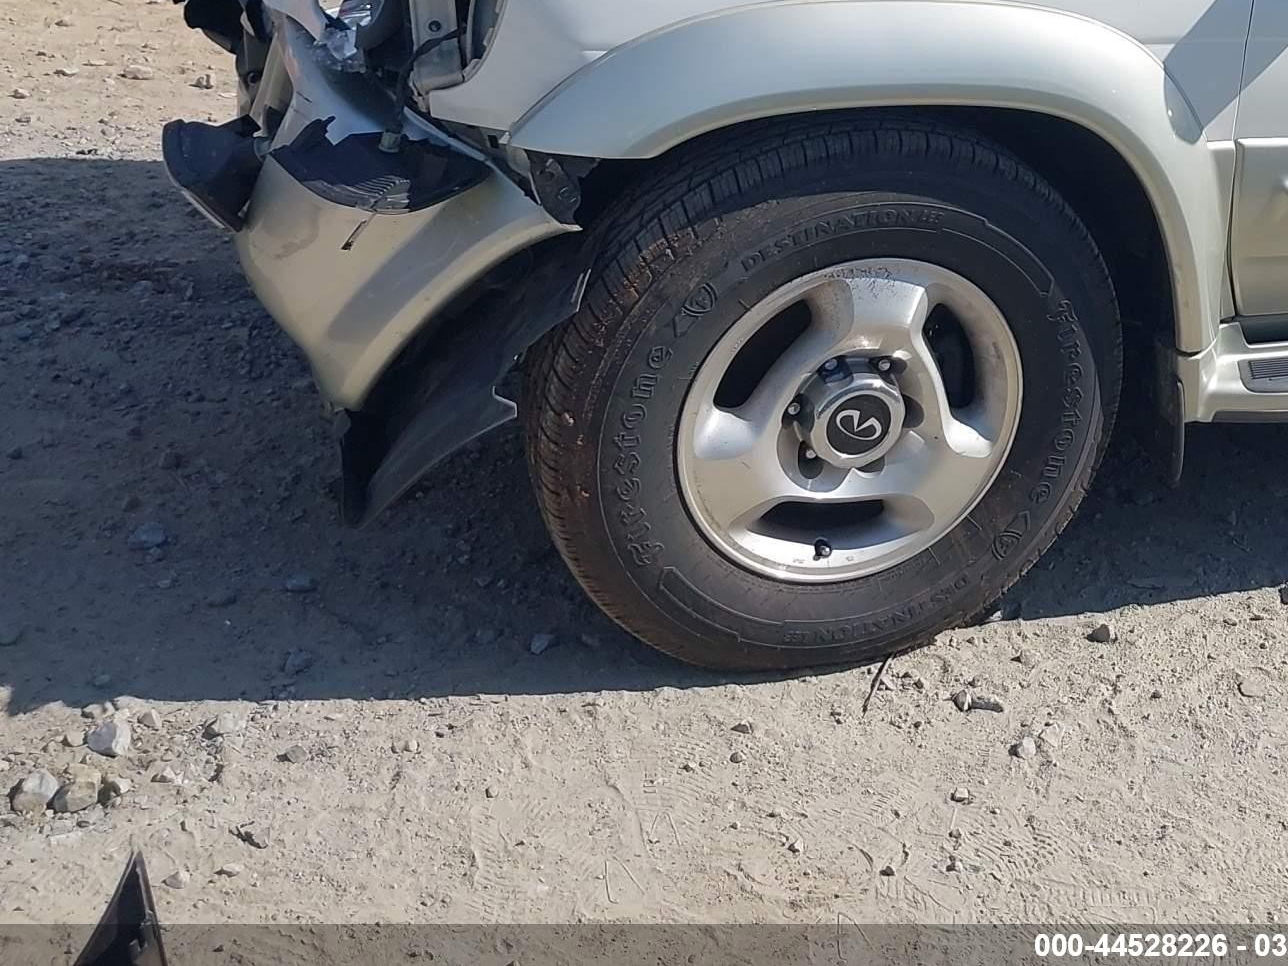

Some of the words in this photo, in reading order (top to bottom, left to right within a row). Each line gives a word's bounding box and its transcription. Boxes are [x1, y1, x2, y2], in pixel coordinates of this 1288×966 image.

[741, 208, 916, 272] DESTINATION
[613, 345, 674, 567] Firestone
[1028, 298, 1084, 504] Firestone
